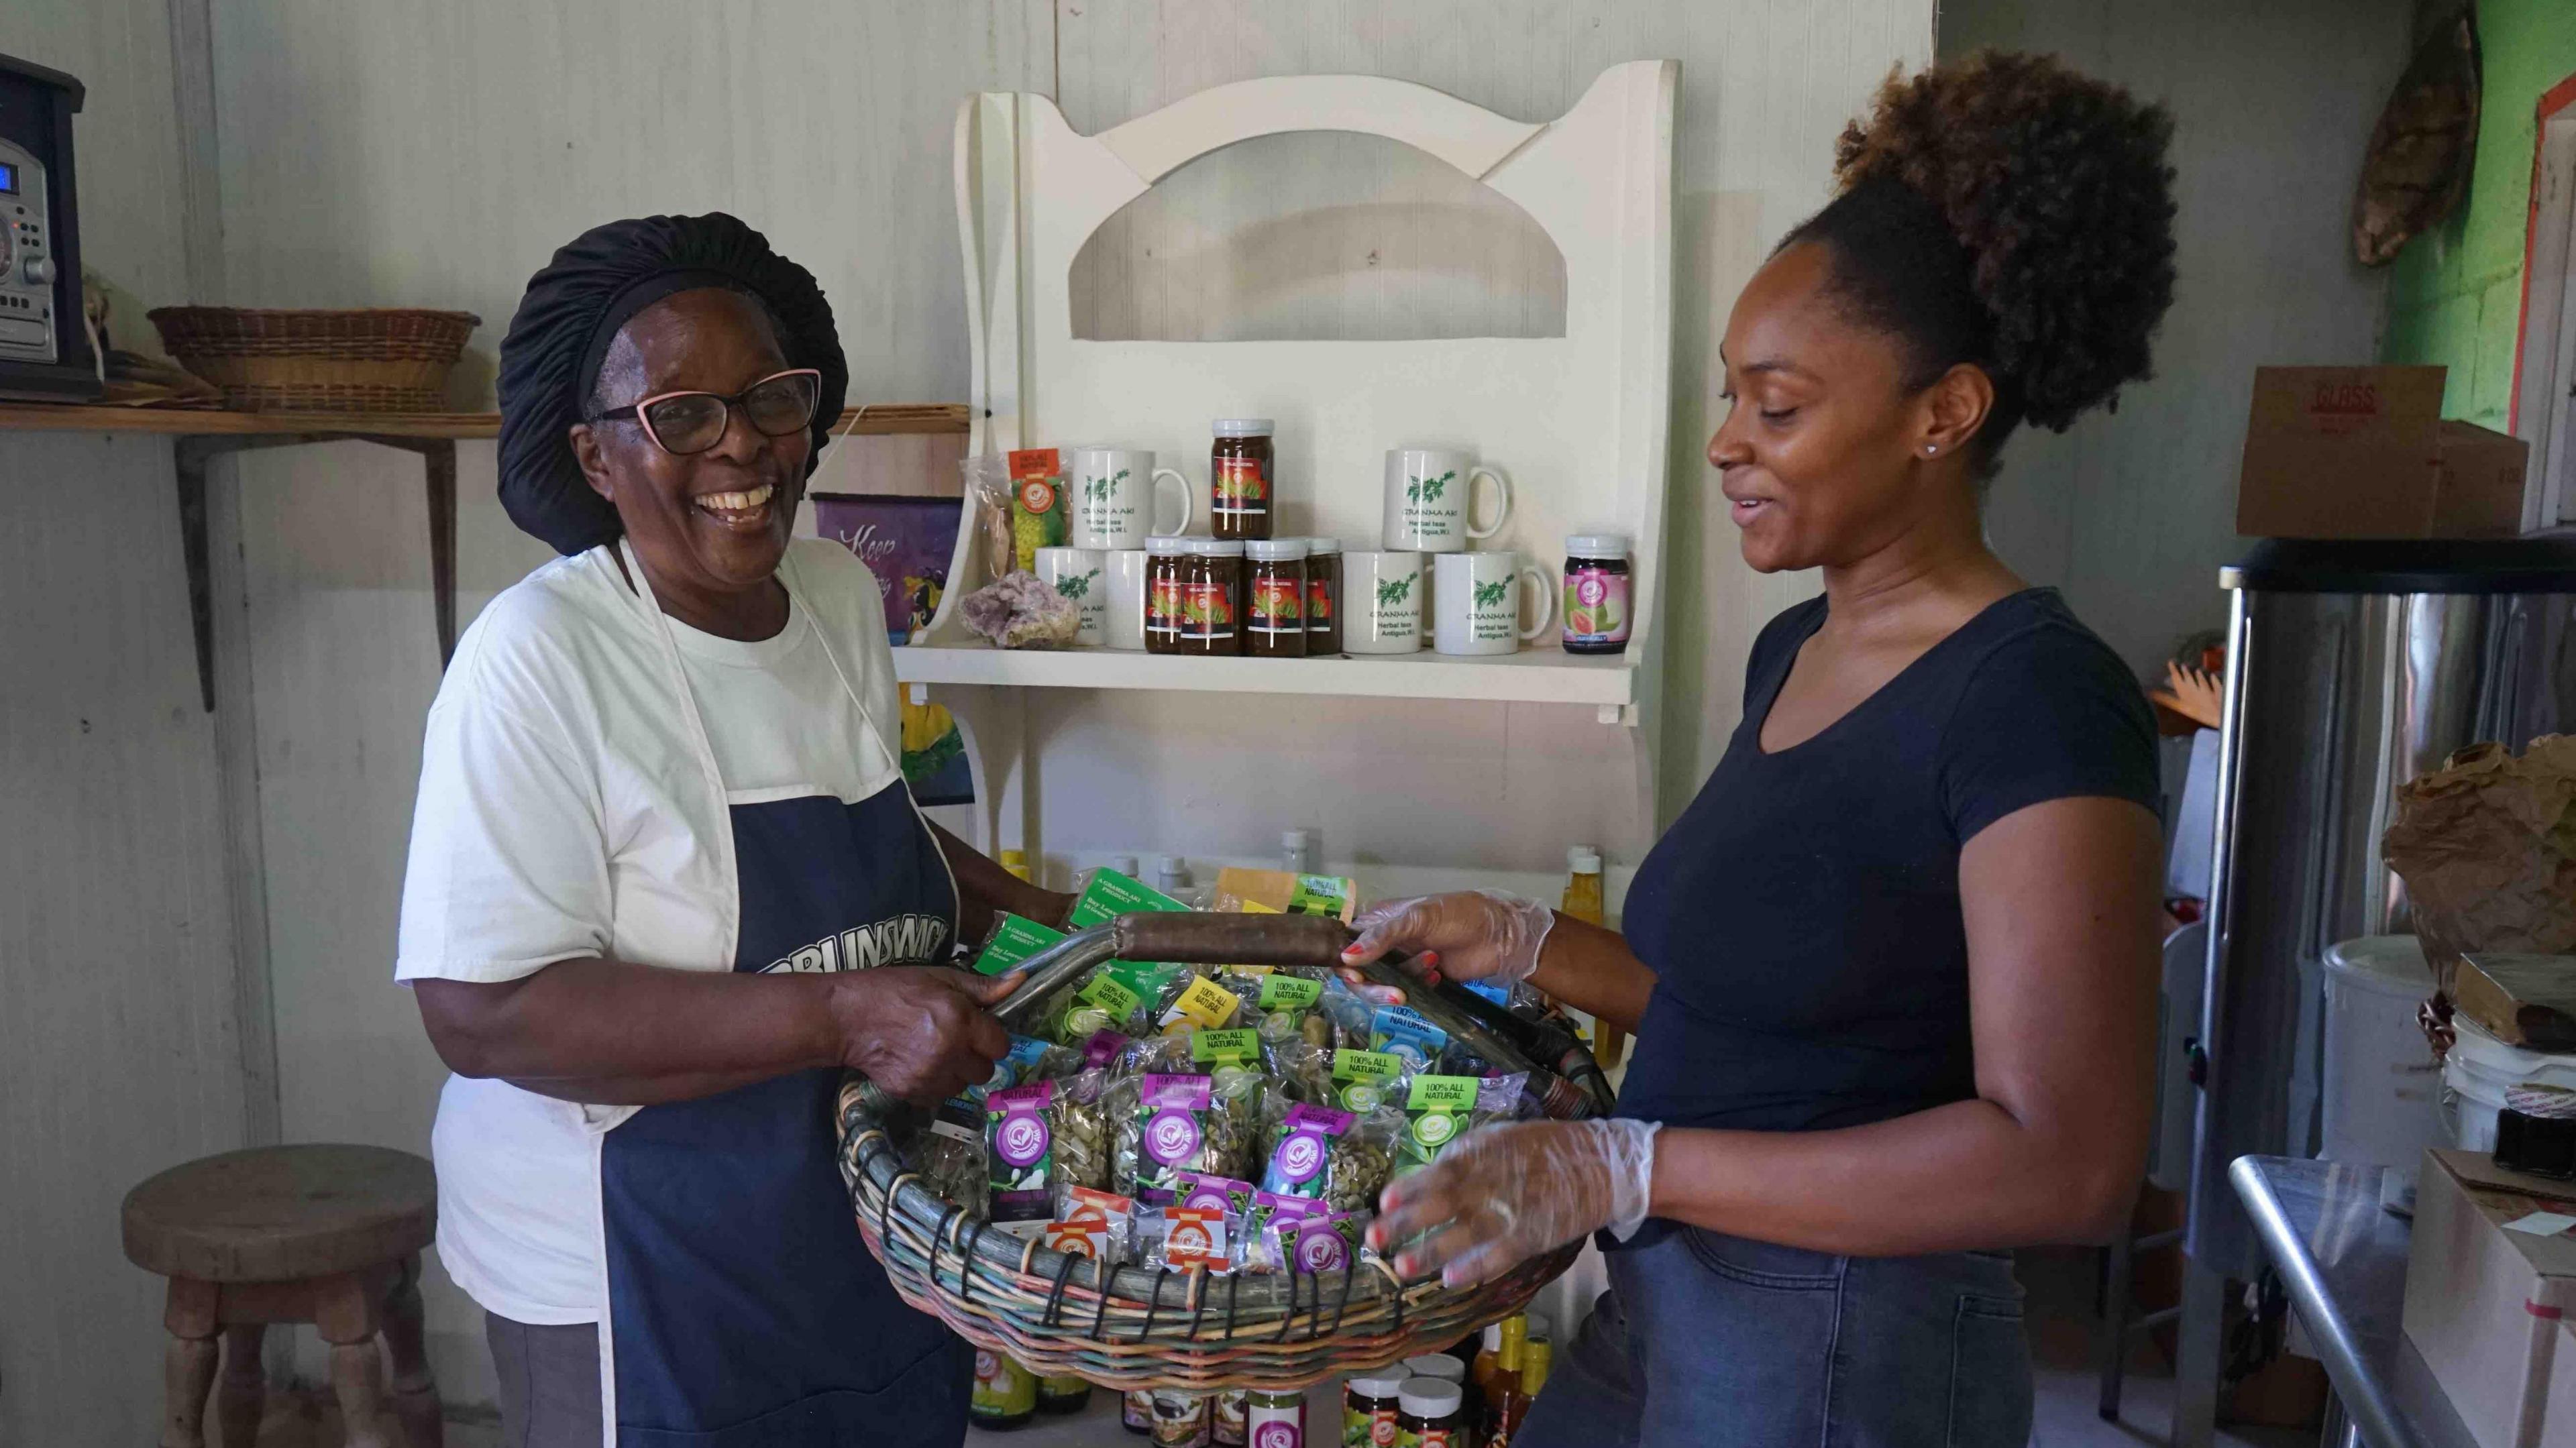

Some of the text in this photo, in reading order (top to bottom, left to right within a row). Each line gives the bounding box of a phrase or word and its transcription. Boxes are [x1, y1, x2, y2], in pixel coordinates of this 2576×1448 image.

[840, 524, 896, 561] Keep
[1102, 886, 1130, 903] PRODUCT
[1304, 887, 1335, 899] NATURAL
[1087, 896, 1101, 908] Bay
[765, 915, 949, 972] RUNSWICK
[1009, 933, 1035, 947] PRODUCT
[991, 944, 1004, 953] Bay
[1102, 983, 1130, 1003] 100% ALL
[1276, 982, 1310, 993] 100% ALL
[1097, 989, 1125, 1009] NATURAL
[1199, 987, 1228, 1007] 100% ALL
[1274, 991, 1307, 999] NATURAL
[1193, 994, 1222, 1015] NATURAL
[1393, 1006, 1417, 1019] 100%
[1389, 1015, 1432, 1034] NATURAL
[1205, 1032, 1246, 1042] 100% ALL
[1208, 1039, 1246, 1049] NATURAL
[1350, 1056, 1389, 1067] 100% ALL
[1348, 1064, 1387, 1074] NATURAL
[1000, 1086, 1043, 1101] NATURAL
[1426, 1083, 1464, 1092] 100% ALL
[1425, 1092, 1462, 1100] NATURAL
